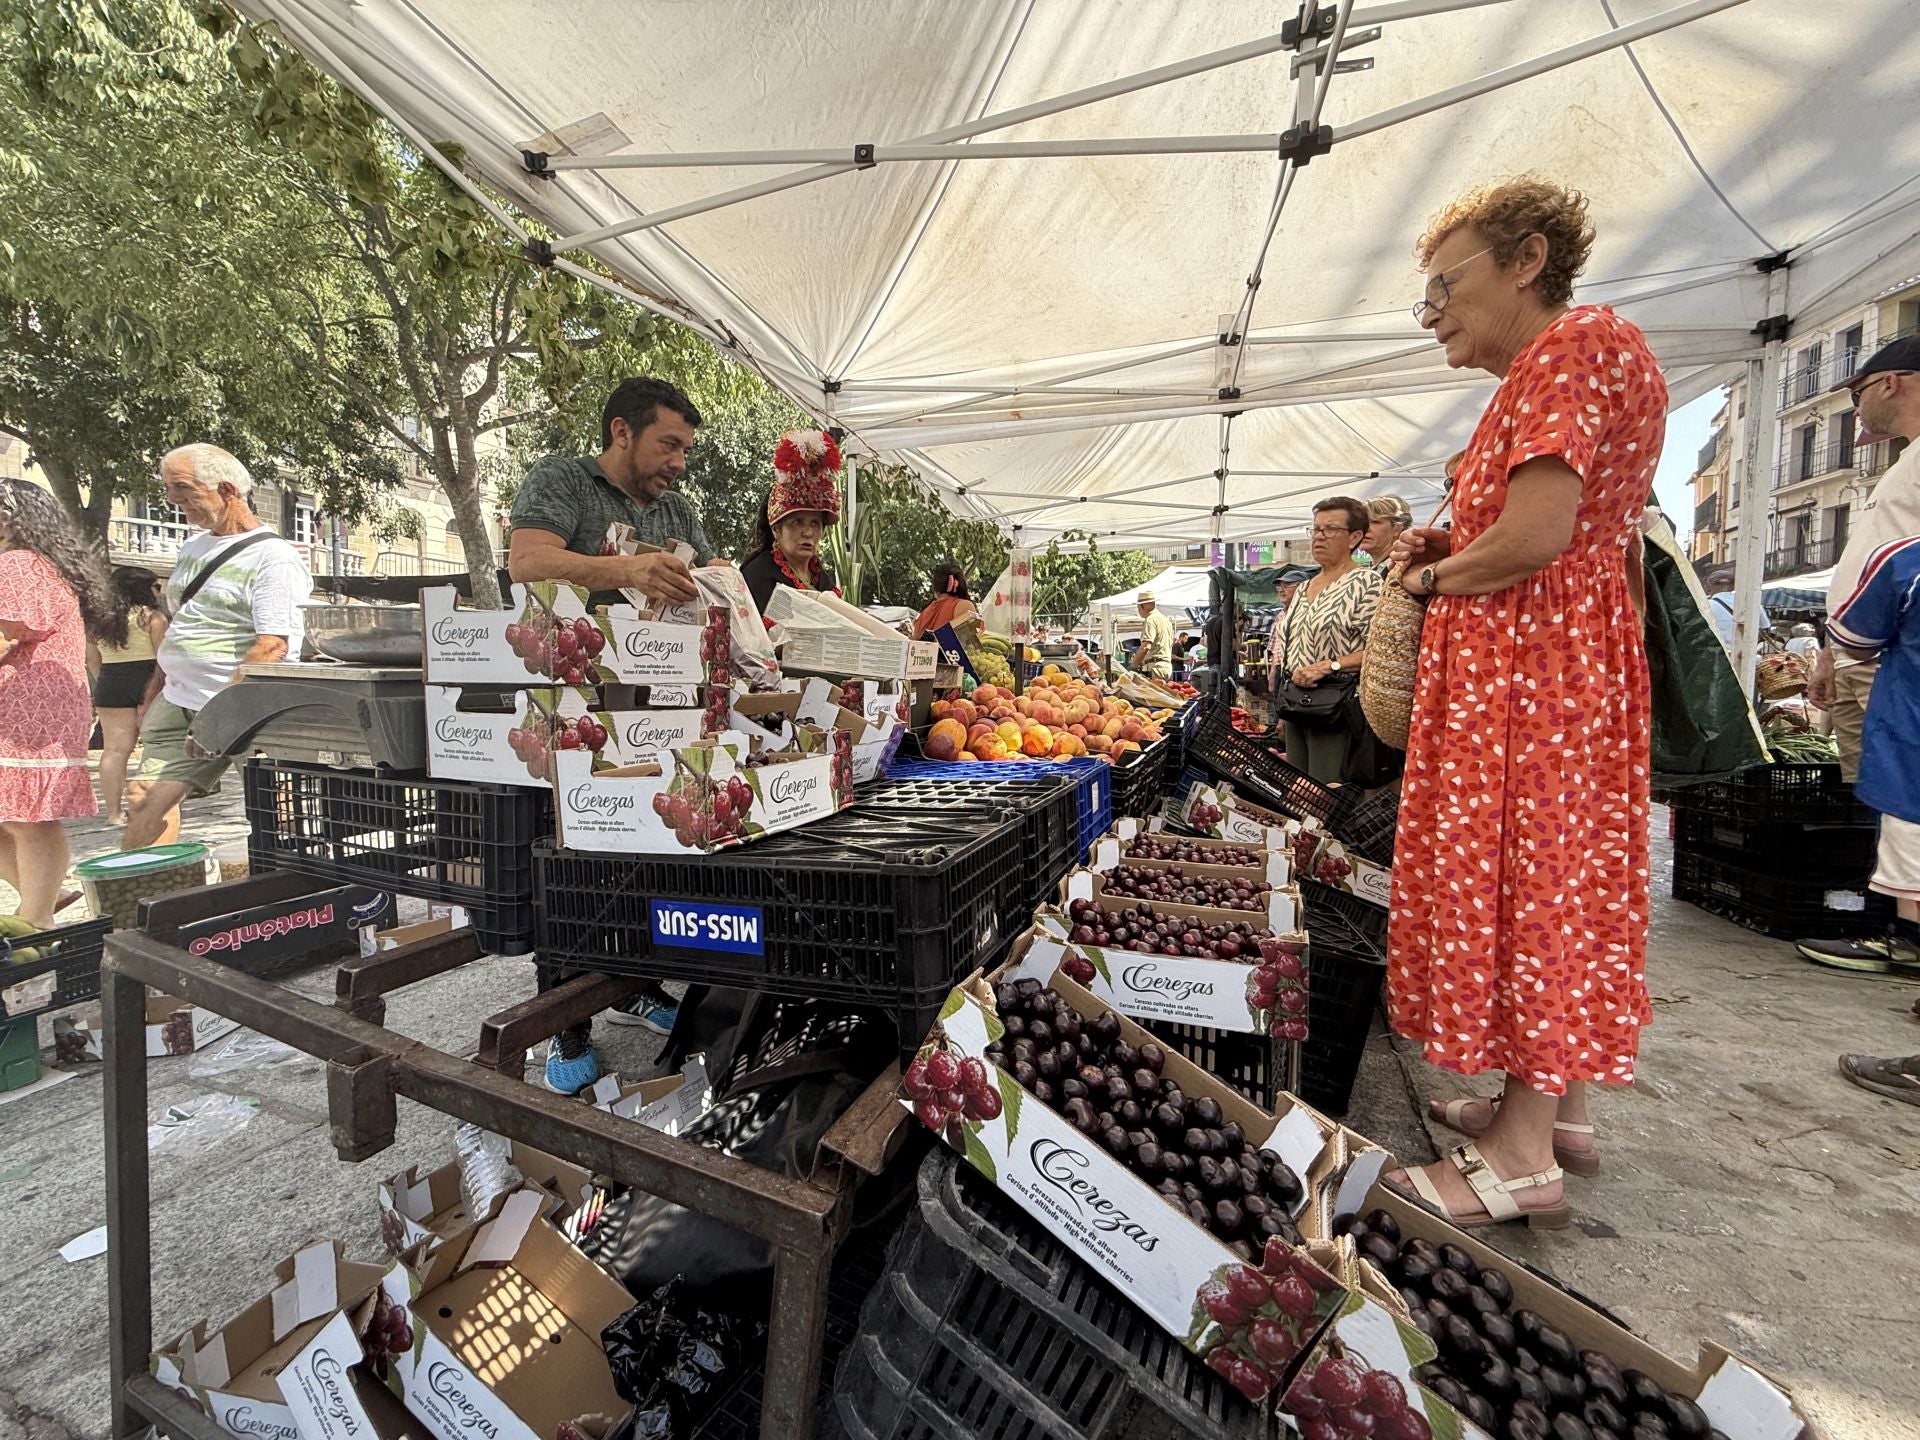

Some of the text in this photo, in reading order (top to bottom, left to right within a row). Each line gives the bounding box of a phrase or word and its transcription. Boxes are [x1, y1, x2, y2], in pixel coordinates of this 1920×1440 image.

[432, 617, 489, 647] Cerezas
[625, 628, 684, 660] Cerezas
[650, 689, 687, 709] Cereza
[435, 715, 493, 747] Cerezas
[626, 717, 684, 748] Cerezas
[568, 783, 634, 817] Cerezas
[770, 770, 817, 803] Cerezas
[189, 903, 334, 956] Platónico
[657, 909, 758, 944] MISS-SUR
[1122, 963, 1214, 1001] Cerezas
[1030, 1138, 1160, 1253] Cerezas
[1006, 1173, 1029, 1196] Cerises
[1028, 1193, 1059, 1221] d'altitude
[1064, 1222, 1080, 1238] High
[1079, 1237, 1106, 1260] altitude
[1105, 1258, 1134, 1283] cherries
[1031, 1183, 1118, 1259] Cerezas cultivadas en altura
[311, 1348, 359, 1436] Cerezas
[428, 1361, 499, 1440] Cerezas
[225, 1406, 298, 1440] Cerezas
